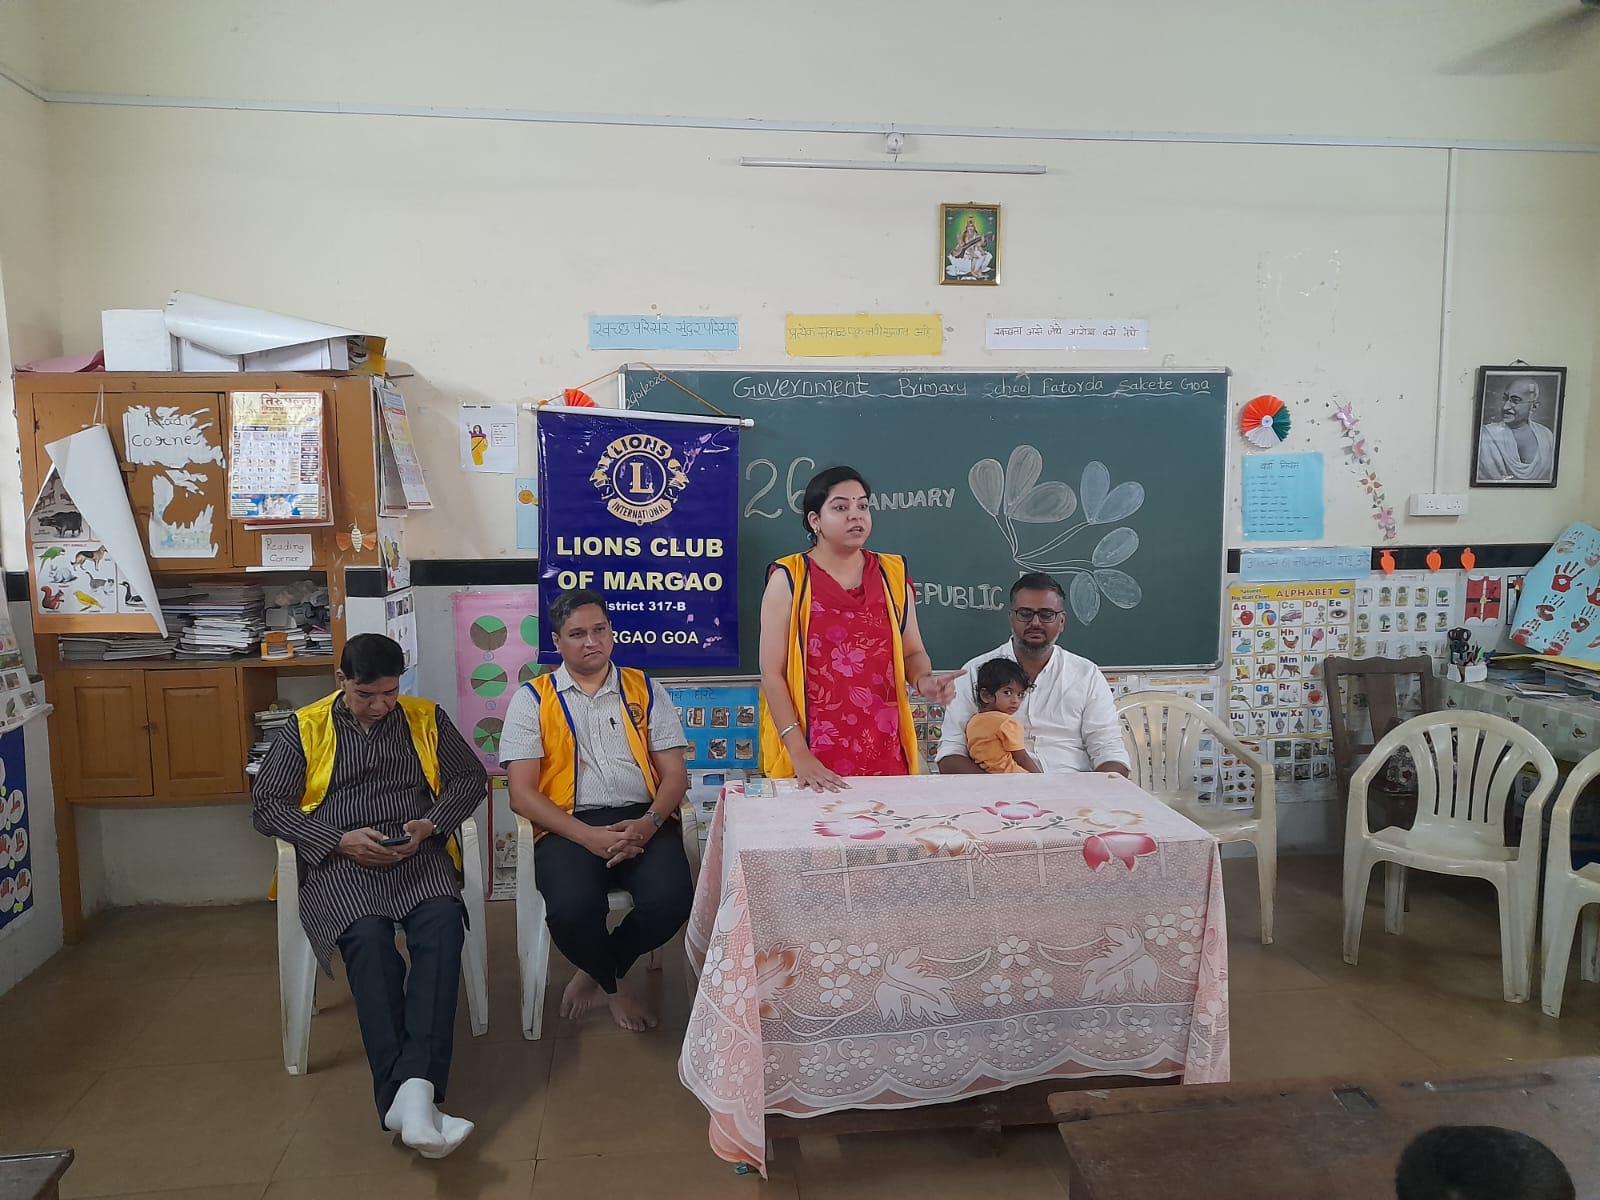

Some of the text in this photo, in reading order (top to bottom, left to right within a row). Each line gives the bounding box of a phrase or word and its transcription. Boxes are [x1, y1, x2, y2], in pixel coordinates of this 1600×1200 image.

[733, 373, 870, 398] Government
[898, 377, 967, 396] Primary
[984, 375, 1031, 395] School
[1180, 377, 1210, 391] Goa
[610, 436, 669, 457] LIONS
[629, 462, 655, 494] L
[744, 456, 956, 519] 26 ANUARY
[611, 502, 669, 520] INTERNATIONAL
[265, 537, 304, 553] Reading
[556, 536, 724, 557] LIONS CLUB
[557, 570, 723, 591] OF MARGAO
[912, 582, 1005, 611] EPUBLIC
[1276, 588, 1334, 597] ALPHABET
[605, 601, 686, 611] istrict 317-B
[1281, 601, 1294, 609] Cc
[1305, 600, 1318, 608] Dd
[1329, 599, 1341, 607] Ee
[612, 630, 699, 644] RGAO GOA
[1232, 630, 1241, 638] Ff
[1256, 630, 1270, 638] Gg
[1281, 628, 1294, 636] Hh
[1328, 627, 1337, 636] Jj
[1232, 658, 1245, 666] Kk
[1256, 657, 1264, 665] Ll
[1231, 685, 1243, 693] Pp
[1255, 684, 1269, 693] Qq
[1303, 682, 1315, 690] Ss
[1270, 710, 1288, 718] Ww
[1290, 709, 1303, 717] Xx
[1310, 708, 1323, 717] Yy
